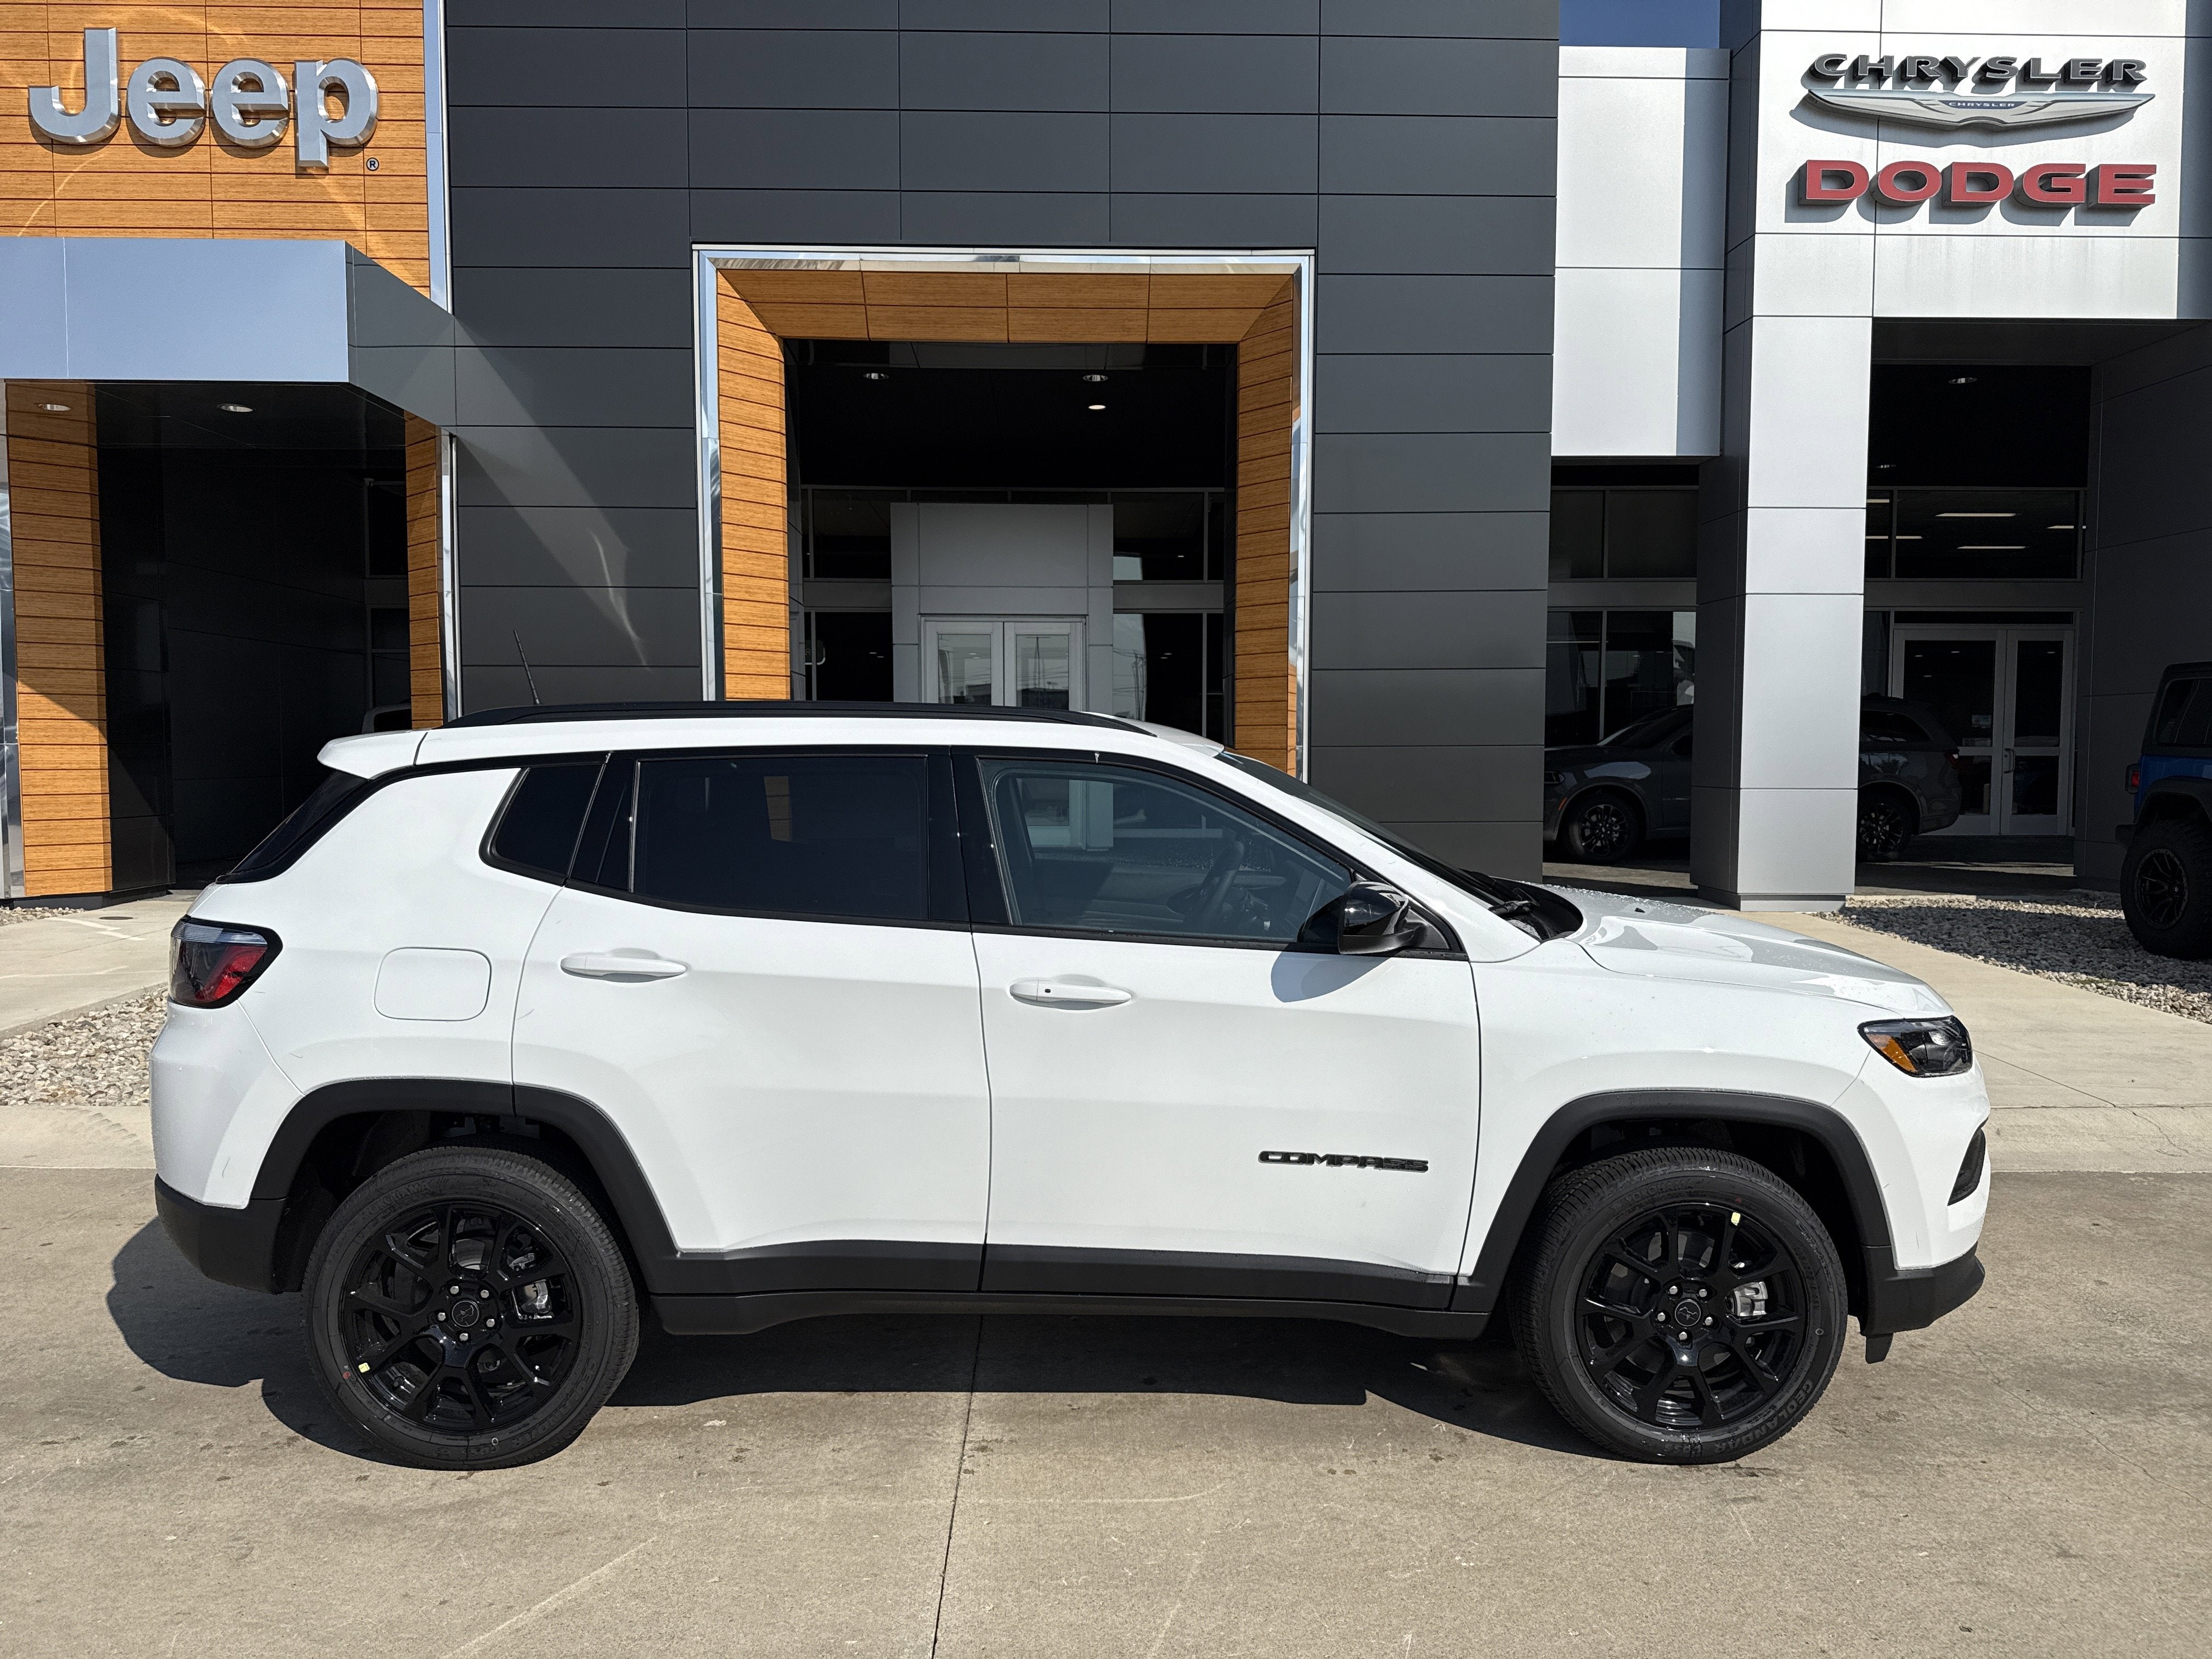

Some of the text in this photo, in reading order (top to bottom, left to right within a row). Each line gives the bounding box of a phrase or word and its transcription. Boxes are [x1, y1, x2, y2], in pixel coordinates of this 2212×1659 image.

[1810, 53, 2148, 82] CHRYSLER
[28, 27, 379, 168] Jeep
[1803, 159, 2157, 206] DODGE
[1259, 1150, 1429, 1173] COMPASS
[362, 1181, 432, 1217] YOKOHAMA
[1625, 1179, 1694, 1204] YOKOHAMA
[511, 1357, 599, 1448] GEOLANDAR
[1713, 1379, 1814, 1454] GEOLANDAR
